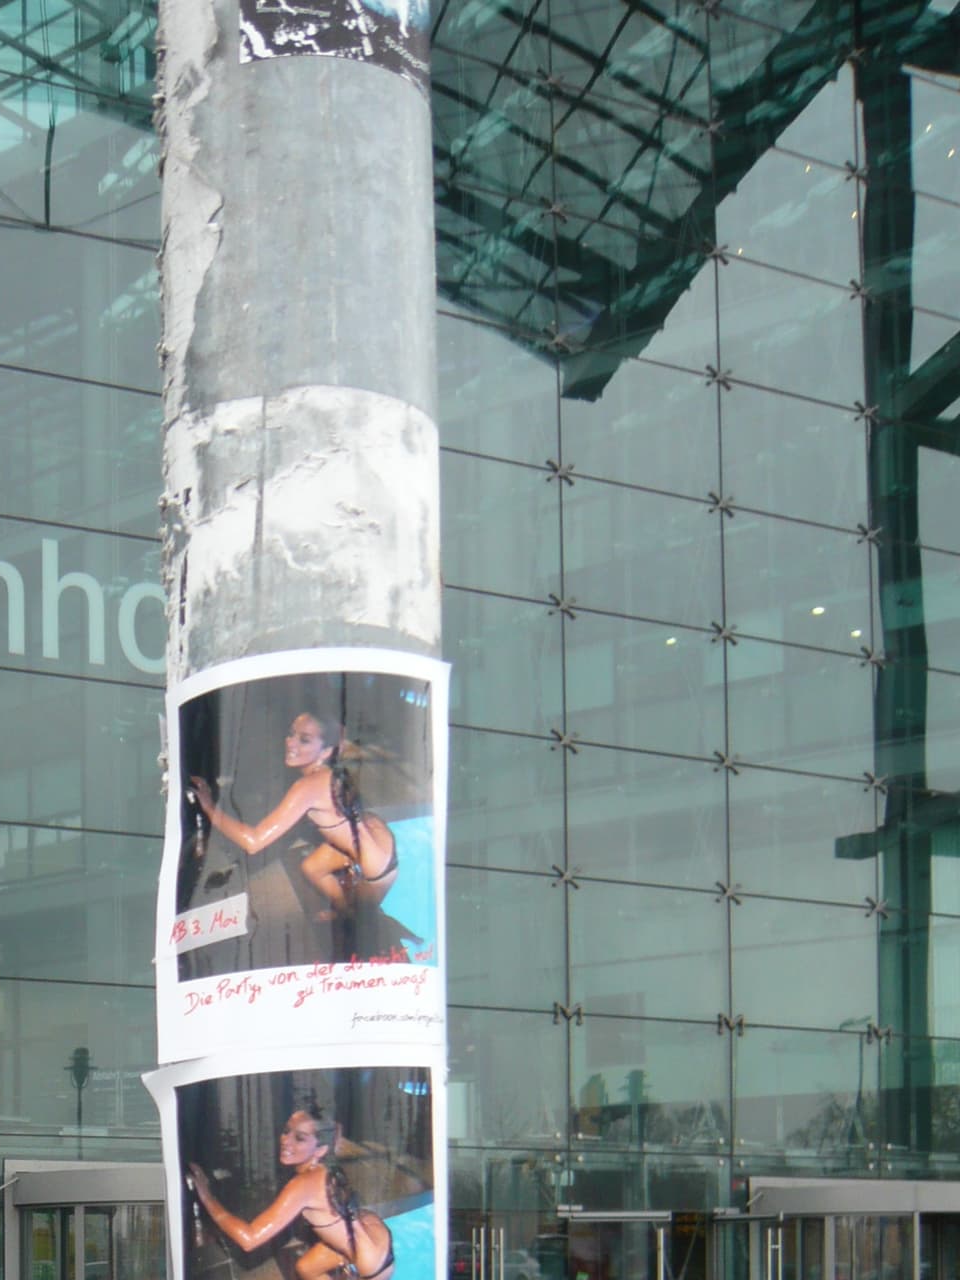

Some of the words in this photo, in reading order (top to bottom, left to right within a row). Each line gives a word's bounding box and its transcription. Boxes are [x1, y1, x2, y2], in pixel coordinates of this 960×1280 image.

[209, 909, 240, 933] Mai
[184, 992, 213, 1016] Die
[269, 971, 300, 985] von
[306, 960, 335, 978] der
